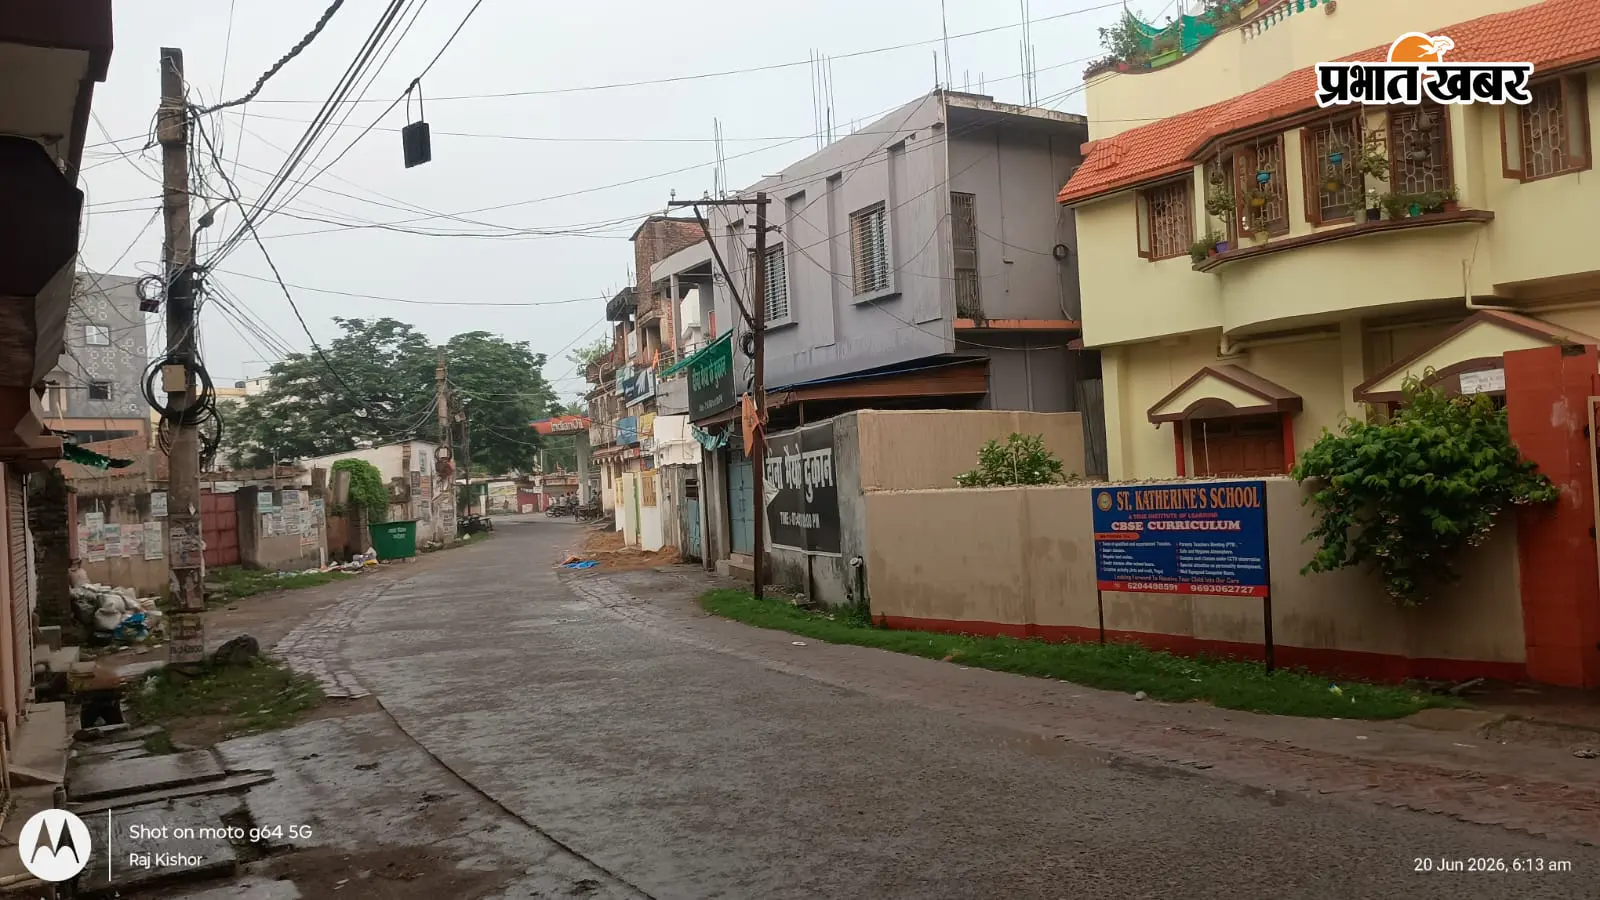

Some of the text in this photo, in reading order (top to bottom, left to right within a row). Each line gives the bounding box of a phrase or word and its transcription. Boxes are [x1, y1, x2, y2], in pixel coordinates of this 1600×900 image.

[802, 448, 833, 503] दुकान
[1116, 485, 1261, 511] ST. KATHERINE'S SCHOOL
[1111, 520, 1241, 532] CBSE CURRICULUM
[1190, 584, 1254, 594] 9693062727
